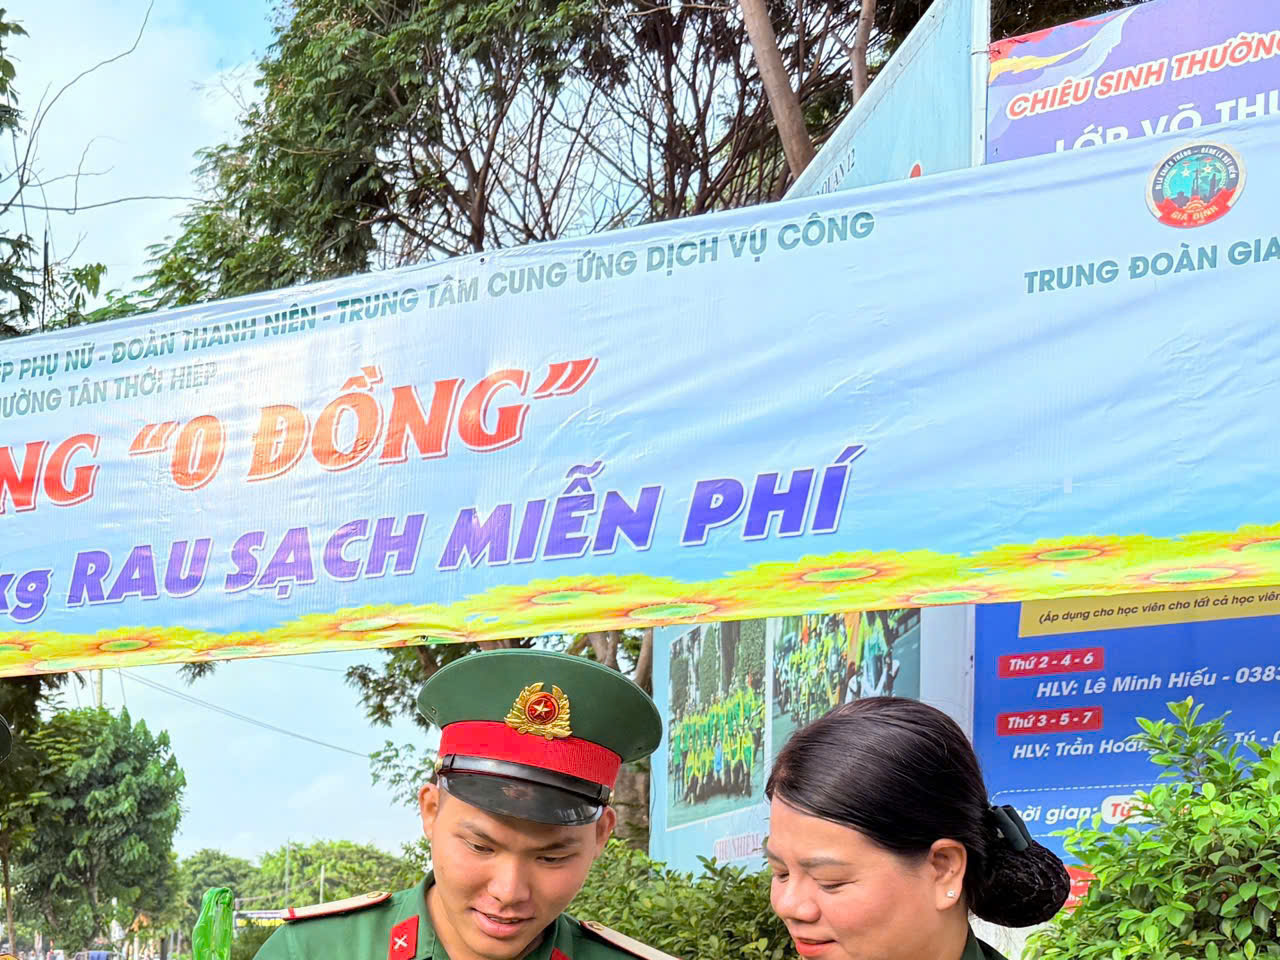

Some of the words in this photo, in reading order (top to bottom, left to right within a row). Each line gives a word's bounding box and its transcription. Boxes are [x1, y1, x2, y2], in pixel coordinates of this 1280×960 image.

[1008, 78, 1091, 118] CHIÊU
[1097, 61, 1166, 98] SINH
[1174, 31, 1280, 79] THƯỜN
[1023, 260, 1120, 295] TRUNG
[1128, 243, 1219, 281] ĐOÀN
[18, 351, 59, 381] PHỤ
[64, 341, 96, 372] NỮ
[111, 328, 176, 364] ĐOÀN
[183, 317, 257, 352] THANH
[263, 303, 318, 338] NIÊN
[337, 287, 419, 324] TRUNG
[425, 276, 479, 309] TÂM
[486, 262, 568, 298] CUNG
[576, 249, 638, 283] ỨNG
[646, 236, 719, 278] DỊCH
[731, 227, 768, 263] VỤ
[778, 211, 876, 251] CÔNG
[68, 377, 107, 408] TÂN
[170, 358, 218, 394] HIỆP
[67, 535, 214, 609] RAU
[225, 513, 428, 600] SẠCH
[437, 459, 665, 573] MIỄN
[679, 444, 867, 548] PHÍ
[1039, 610, 1060, 624] (Áp
[1061, 609, 1090, 623] dụng
[1092, 606, 1114, 618] cho
[1116, 604, 1139, 617] học
[1141, 601, 1166, 613] viên
[1168, 599, 1191, 611] cho
[1193, 596, 1211, 609] tất
[1213, 594, 1229, 607] cả
[1231, 594, 1255, 607] học
[1009, 656, 1037, 672] Thứ
[1038, 656, 1049, 669] 2
[1060, 654, 1072, 667] 4
[1083, 652, 1094, 665] 6
[1036, 679, 1080, 698] HLV:
[1083, 677, 1107, 695] Lê
[1111, 672, 1162, 692] Minh
[1167, 665, 1217, 689] Hiếu
[1007, 714, 1036, 729] Thứ
[1036, 714, 1048, 727] 3
[1059, 713, 1070, 726] 5
[1081, 711, 1093, 725] 7
[1012, 743, 1051, 760] HLV:
[1055, 736, 1094, 757] Trần
